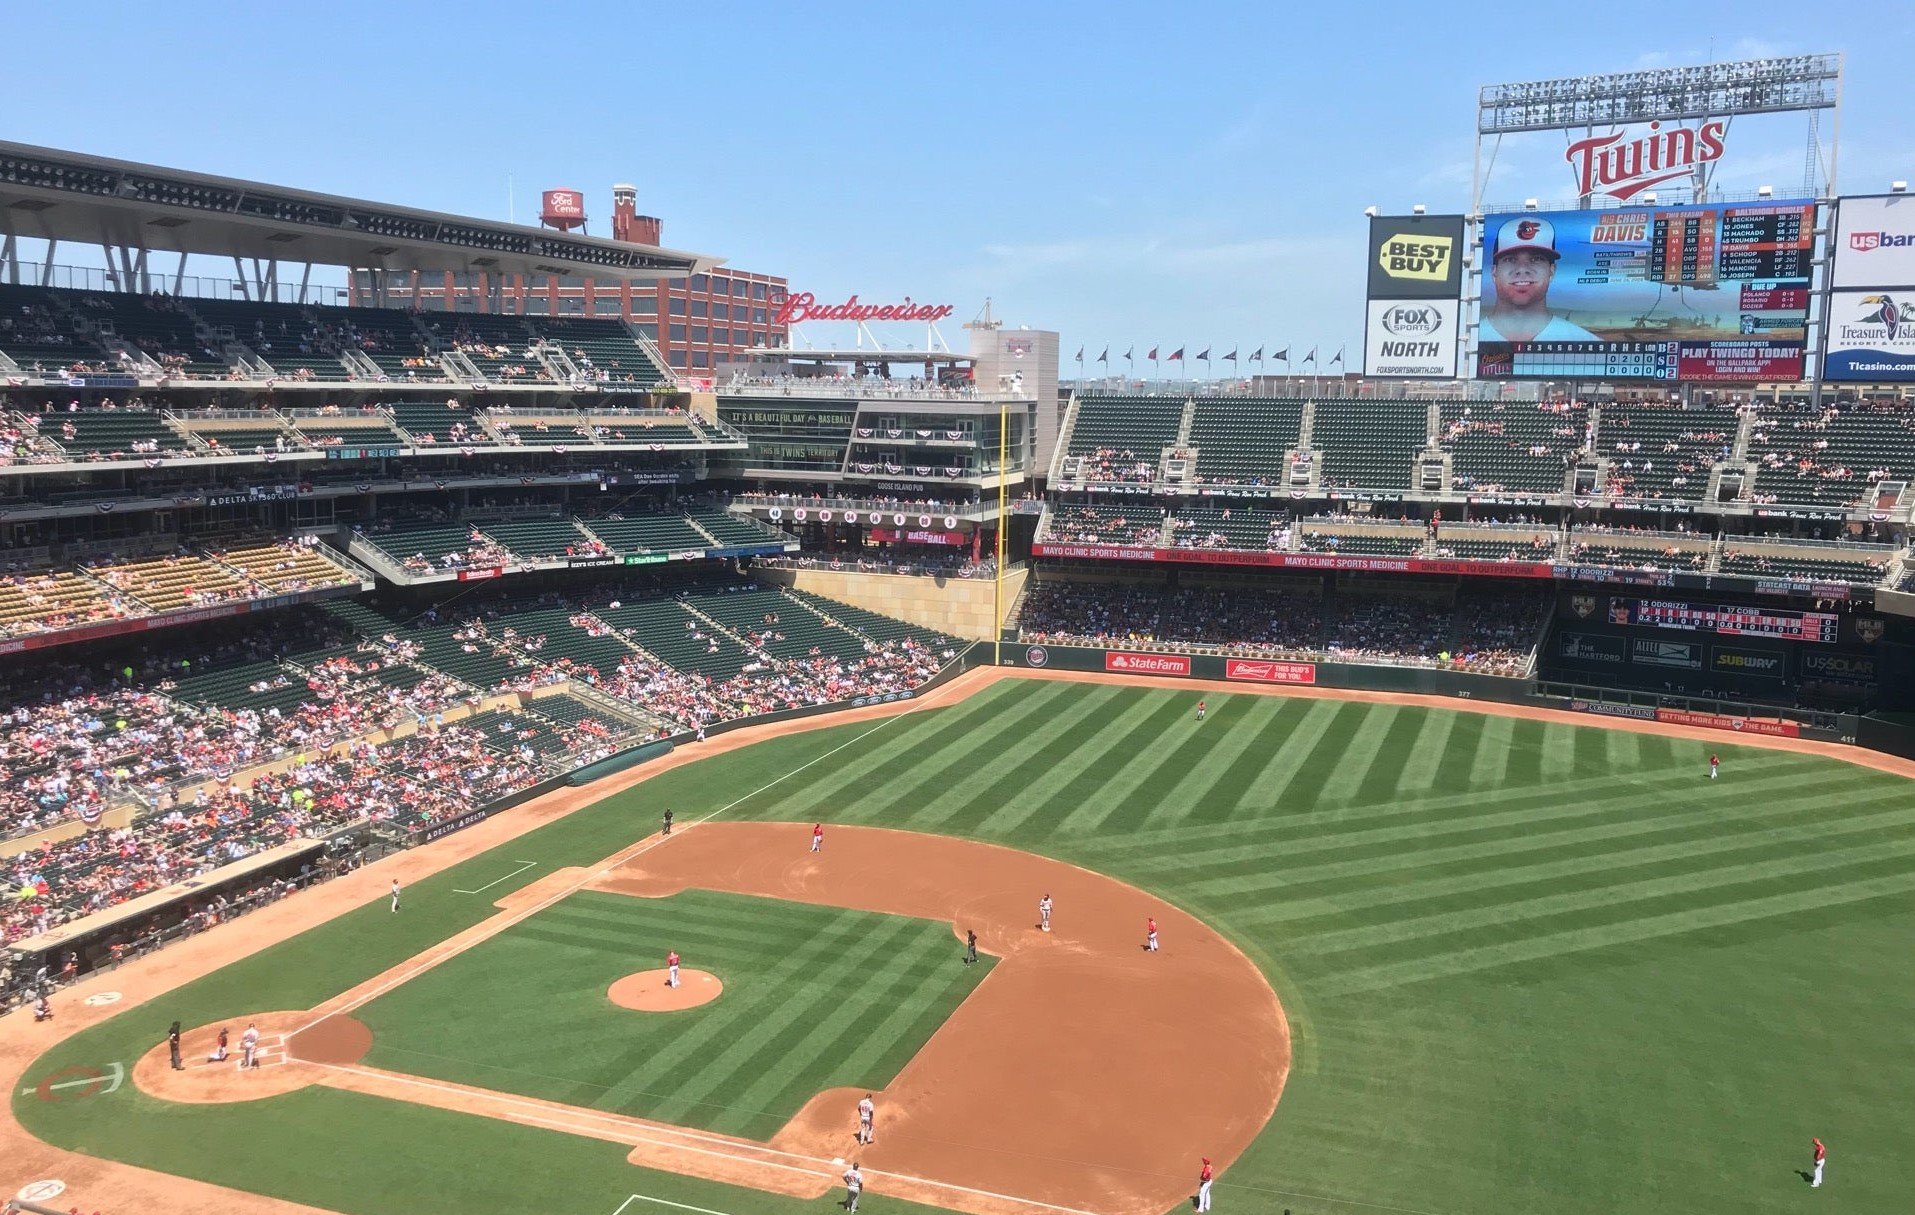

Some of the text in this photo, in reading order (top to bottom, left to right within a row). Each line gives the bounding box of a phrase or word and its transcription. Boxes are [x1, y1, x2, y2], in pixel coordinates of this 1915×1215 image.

[1566, 120, 1725, 200] Twins
[551, 193, 572, 205] Ford
[555, 205, 580, 213] Center
[1735, 206, 1805, 216] BALTIMORE ORIOLES
[1617, 214, 1646, 223] CHRIS
[1593, 225, 1646, 242] DAVIS
[1389, 241, 1450, 259] BEST
[1390, 256, 1443, 273] BUY
[769, 292, 953, 323] Budweiser
[1394, 309, 1429, 325] FOX
[1393, 324, 1431, 332] SPORTS
[1840, 325, 1886, 338] Treasure
[1381, 341, 1439, 358] NORTH
[1657, 343, 1666, 352] B
[1682, 347, 1799, 358] PLAY TWINGO TODAY!
[1658, 356, 1665, 365] S
[1376, 366, 1444, 374] FOXSPORTSNORTH.COM
[1668, 370, 1674, 378] 2
[733, 413, 852, 424] IT'S A BEAUTIFUL DAY BASEBALL
[760, 447, 839, 457] THIS TWINS TERRITORY
[894, 483, 912, 491] ISLAND
[913, 484, 924, 492] PUB
[219, 496, 246, 504] DELTA
[908, 532, 947, 544] BASEBALL
[1043, 547, 1063, 555] MAYO
[1064, 548, 1088, 557] CLINIC
[1090, 549, 1117, 558] SPORTS
[1119, 550, 1155, 559] MEDICINE
[1167, 552, 1181, 560] ONE
[1184, 553, 1201, 562] GOAL
[1207, 554, 1216, 562] TO
[1285, 557, 1408, 570] MAYO CLINIC SPORTS MEDICINE
[1580, 568, 1614, 576] ODORIZZI
[1758, 581, 1791, 589] STATCAST
[1793, 583, 1811, 591] DATA
[1651, 602, 1688, 610] ODORIZZI
[1580, 651, 1620, 661] HARTFORD
[1717, 655, 1778, 669] SUBWAY
[1291, 666, 1309, 674] BUD'S
[1588, 705, 1655, 718] COMMUNITY FUND
[1660, 713, 1690, 721] GETTING
[1692, 716, 1712, 724] MORE
[1714, 718, 1731, 726] KIDS
[1745, 722, 1759, 730] THE
[1841, 735, 1856, 743] 411
[465, 810, 486, 823] DELTA
[433, 824, 455, 837] DELTA
